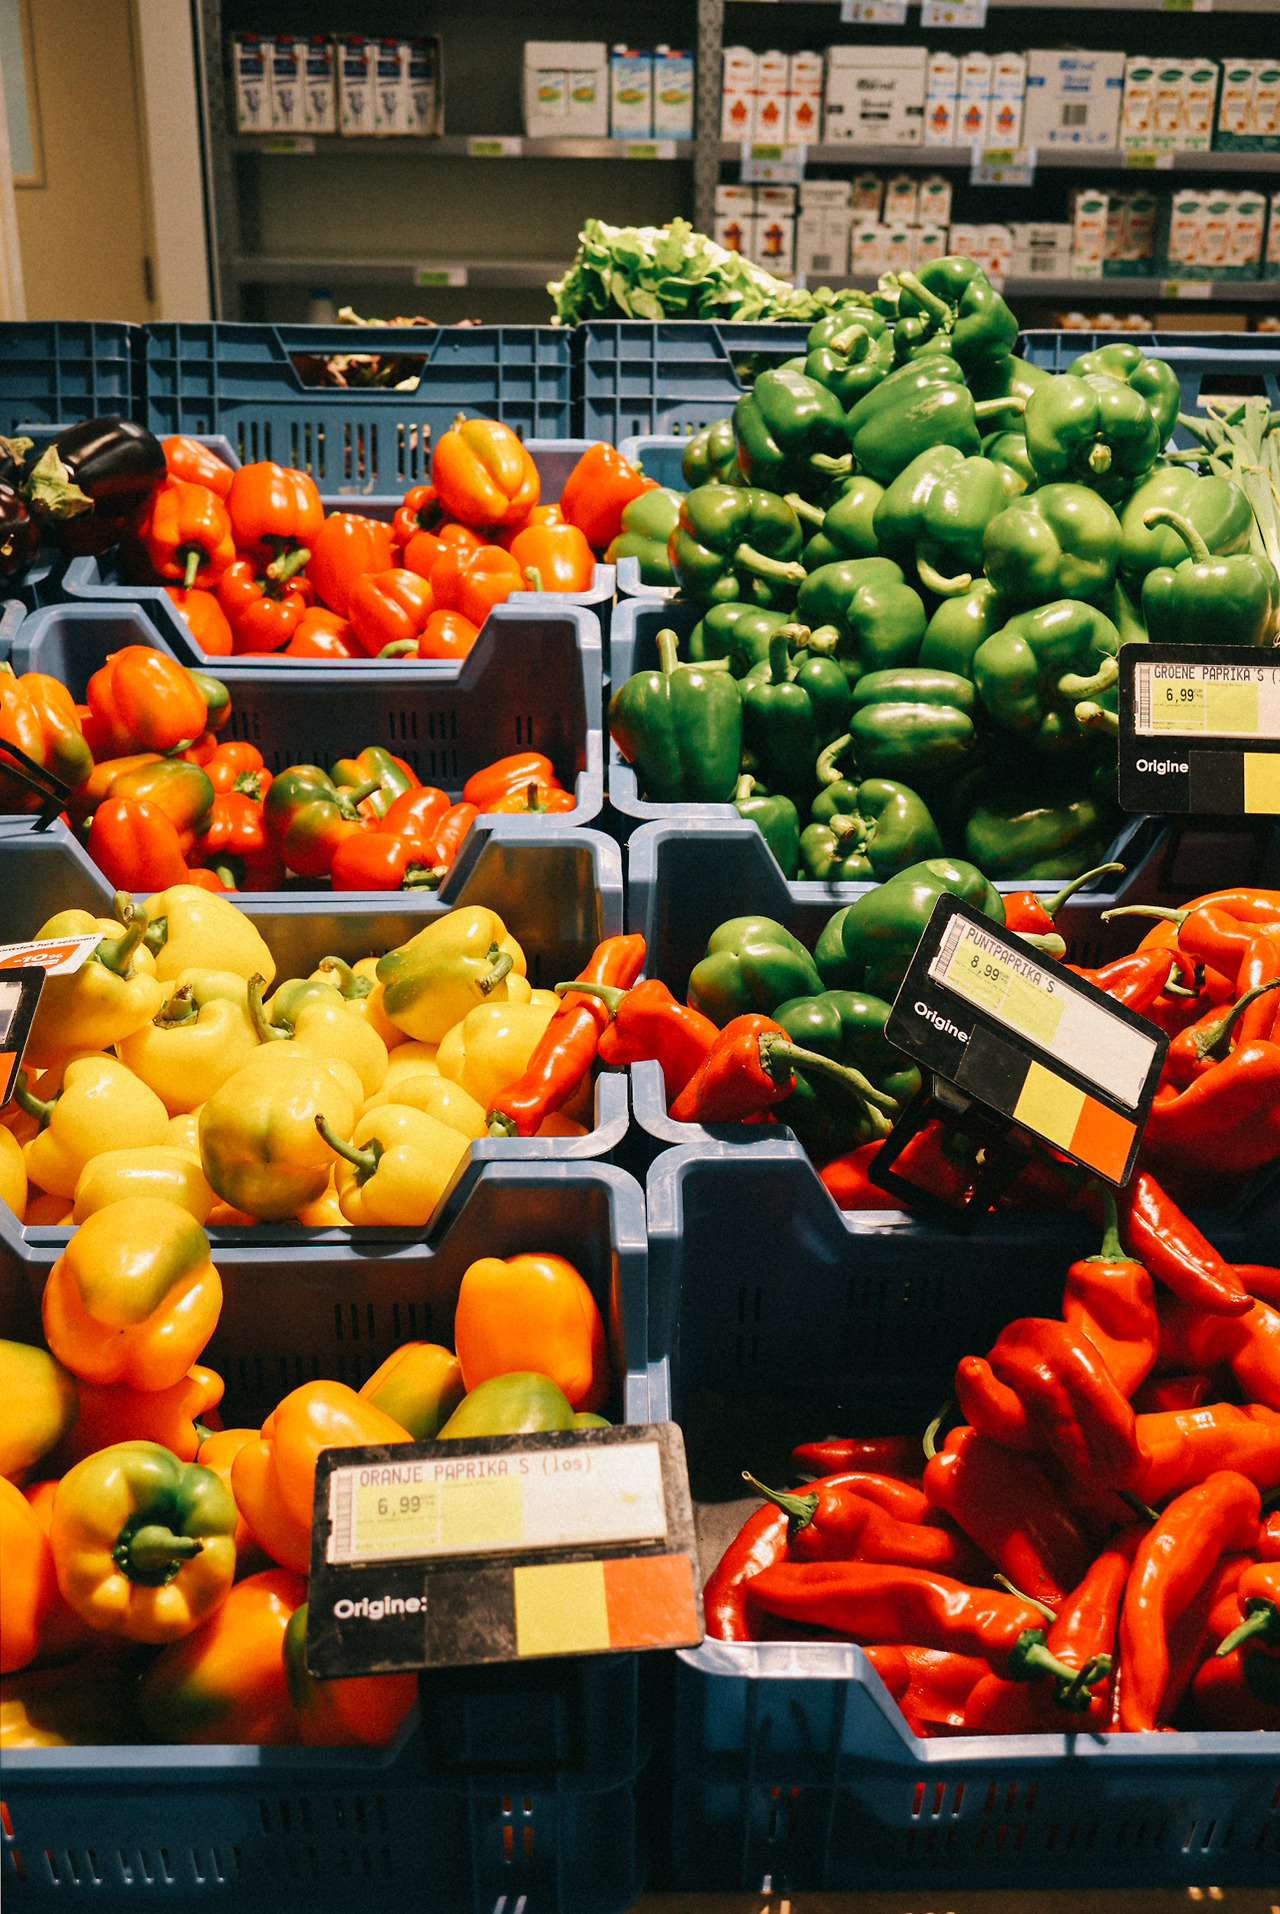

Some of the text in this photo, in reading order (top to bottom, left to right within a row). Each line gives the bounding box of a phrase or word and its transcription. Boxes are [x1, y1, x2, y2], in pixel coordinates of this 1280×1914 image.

[1154, 665, 1195, 679] GROENE
[1203, 666, 1264, 681] PAPRIKA'S
[1166, 688, 1194, 703] 6,99
[1136, 759, 1189, 775] Origine
[14, 952, 63, 963] -10%
[966, 927, 1056, 993] PUNTPAPRIKA'S
[970, 955, 1000, 981] 8,99
[360, 1450, 591, 1487] ORANJE PAPRIKA'S (los)
[378, 1495, 421, 1517] 6,99
[334, 1595, 428, 1620] Origine:
